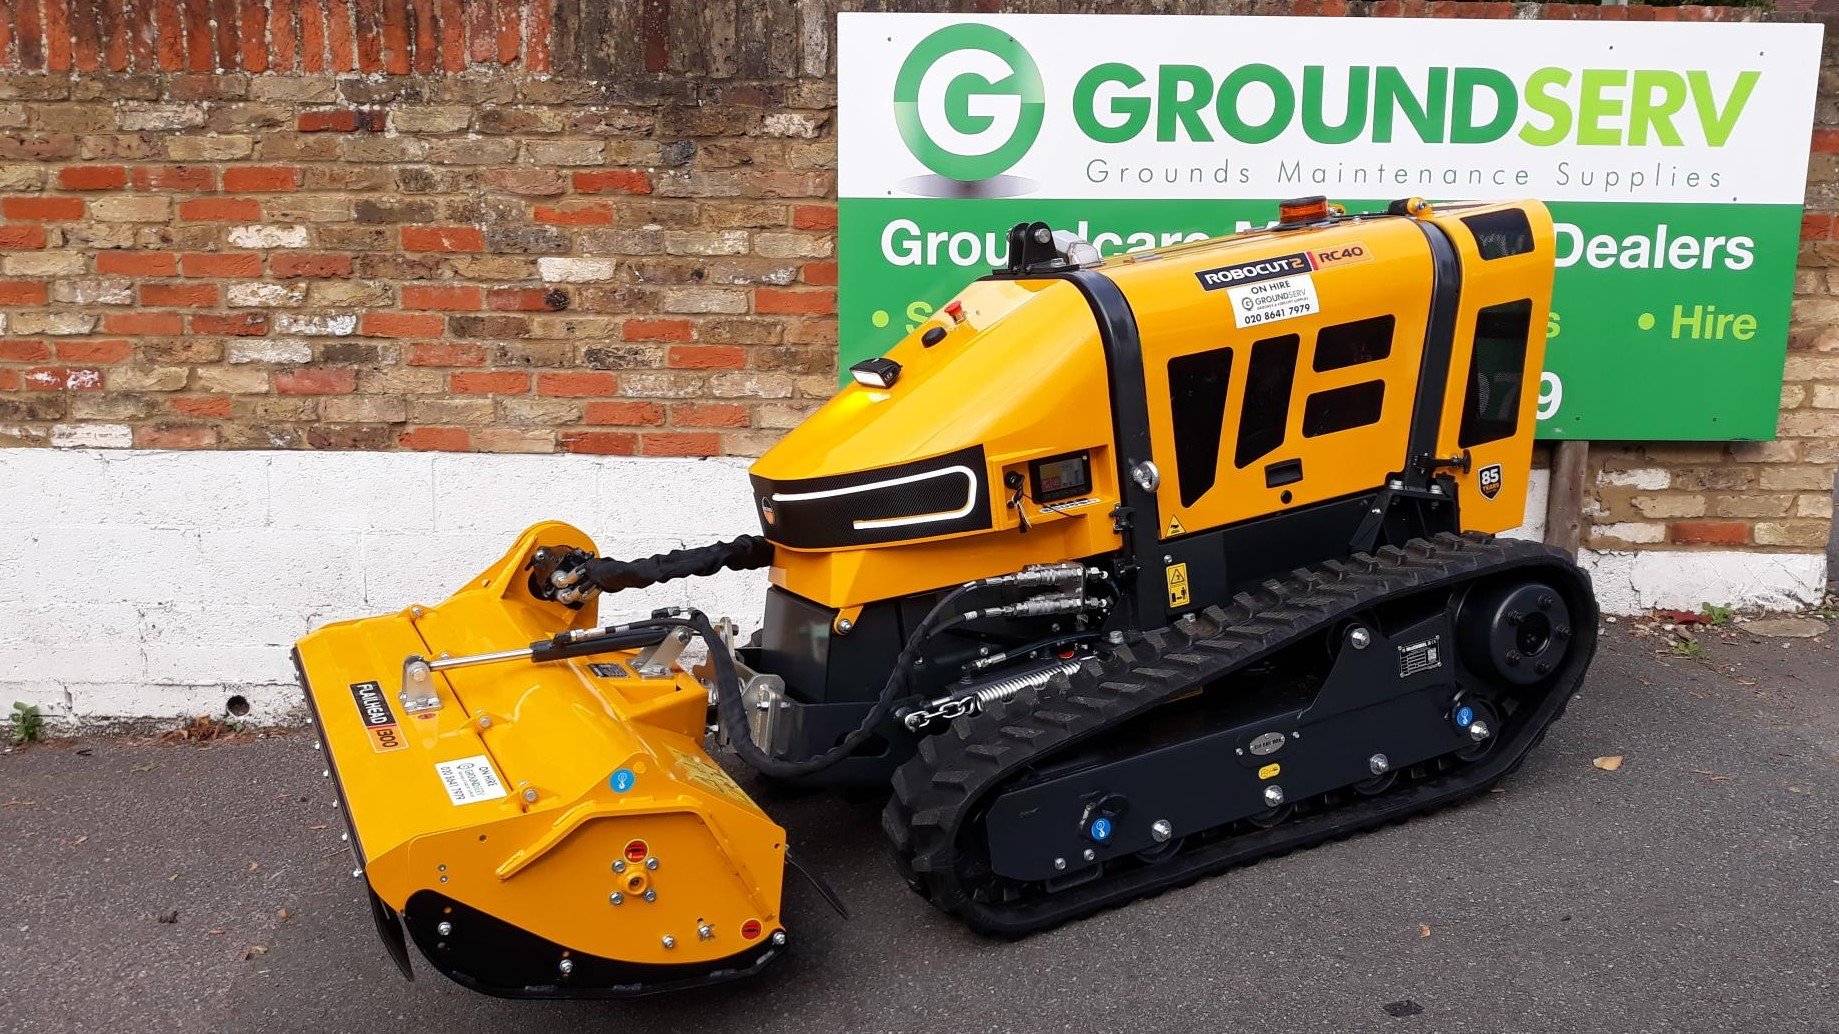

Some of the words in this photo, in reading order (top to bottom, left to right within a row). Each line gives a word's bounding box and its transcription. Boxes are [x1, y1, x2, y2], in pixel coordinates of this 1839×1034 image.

[1072, 61, 1763, 148] GROUNDSERV
[1085, 157, 1251, 185] Grounds
[1277, 158, 1529, 187] Maintenance
[1556, 161, 1721, 194] Supplies
[1318, 245, 1365, 264] RC40
[1553, 222, 1755, 271] Dealers
[1250, 284, 1267, 295] ON
[1268, 280, 1291, 292] HIRE
[1255, 288, 1306, 305] GROUNDSERV
[1244, 313, 1262, 325] 020
[1264, 308, 1286, 321] 8641
[1288, 303, 1311, 316] 7979
[1670, 304, 1758, 341] Hire
[1481, 468, 1500, 485] 85
[356, 683, 388, 725] FLAILHEAD
[375, 727, 399, 749] 1300
